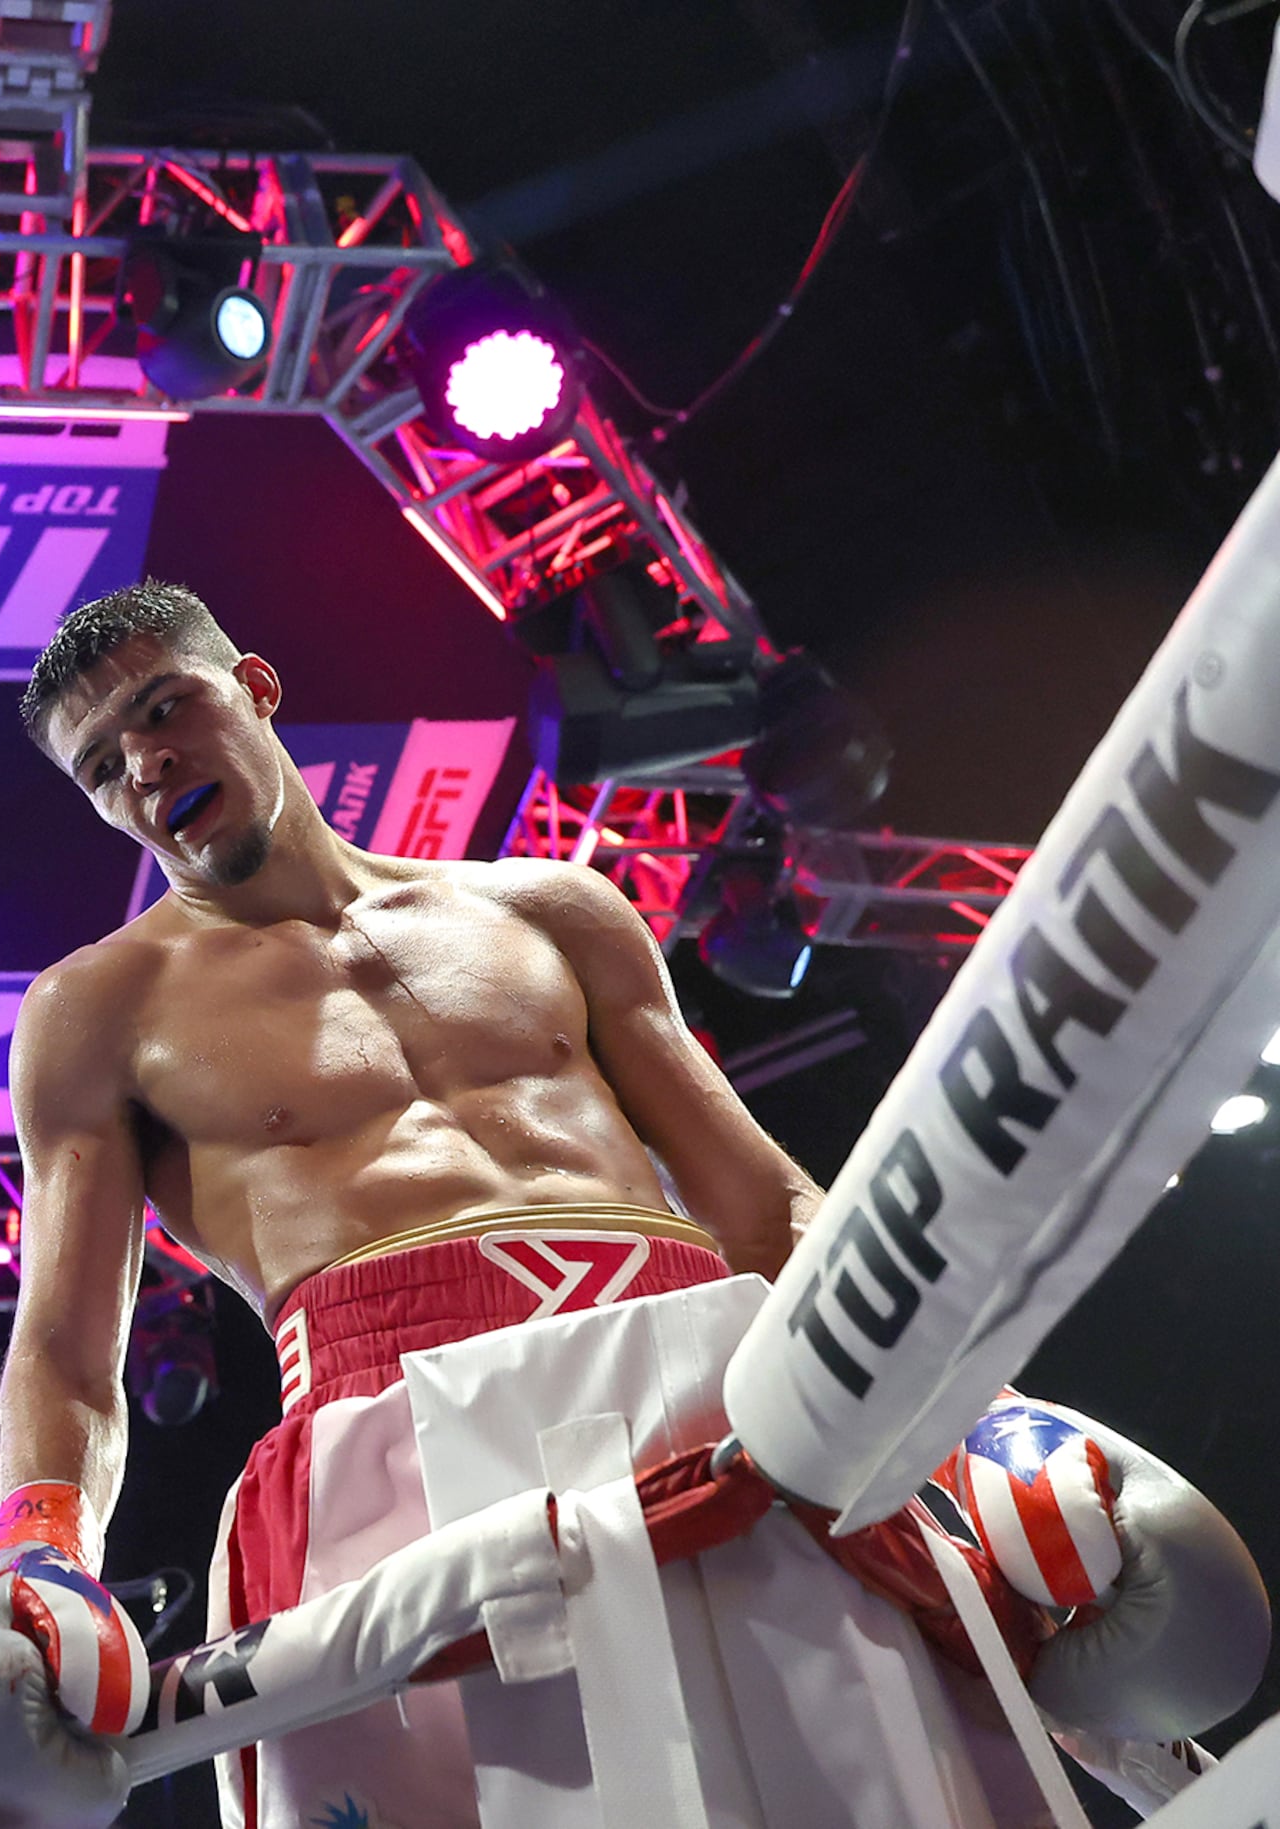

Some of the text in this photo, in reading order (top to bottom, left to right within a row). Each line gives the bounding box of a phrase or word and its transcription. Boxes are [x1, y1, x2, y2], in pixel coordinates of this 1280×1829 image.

[11, 484, 120, 516] TOP
[331, 761, 379, 843] ANK
[395, 768, 471, 860] SPN
[788, 678, 1280, 1400] TOP RANK
